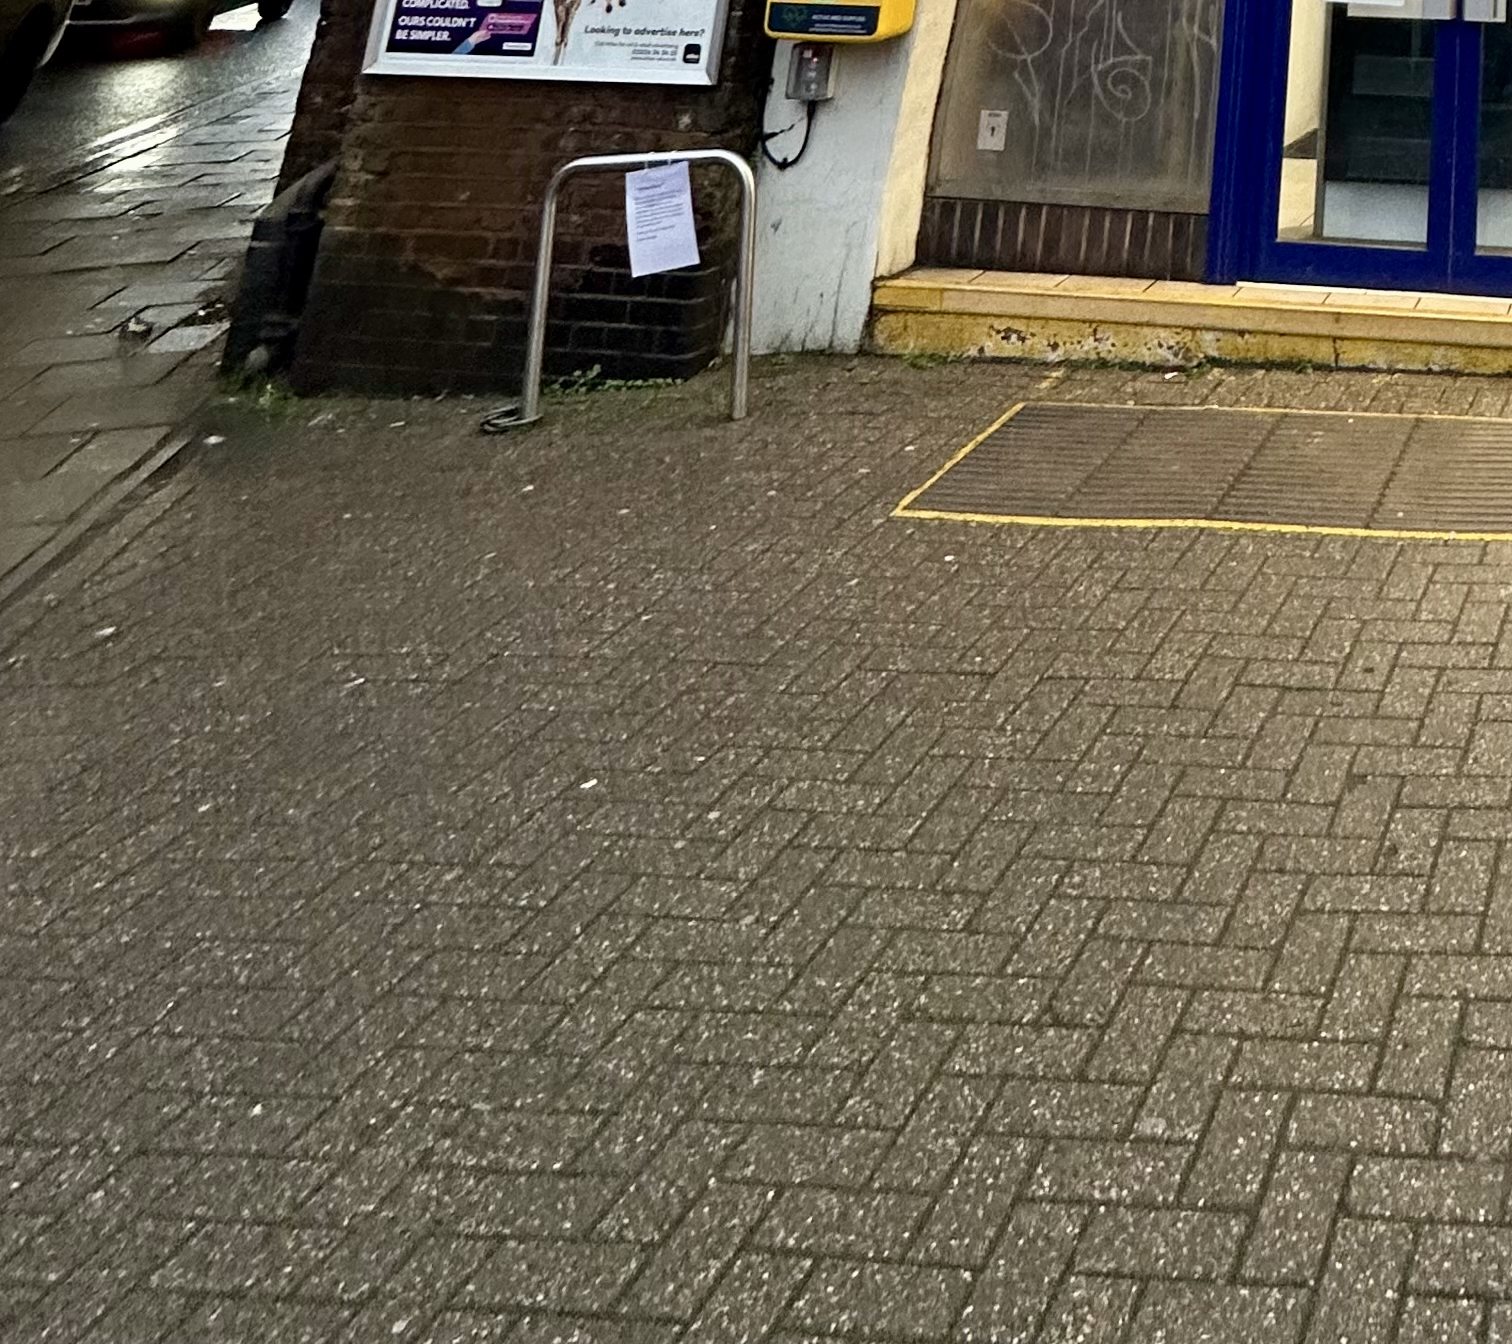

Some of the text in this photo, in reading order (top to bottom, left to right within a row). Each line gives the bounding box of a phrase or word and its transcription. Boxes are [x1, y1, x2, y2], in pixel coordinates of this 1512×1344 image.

[398, 15, 425, 26] OURS
[395, 29, 409, 40] BE
[584, 25, 705, 37] Looking to advertise here?
